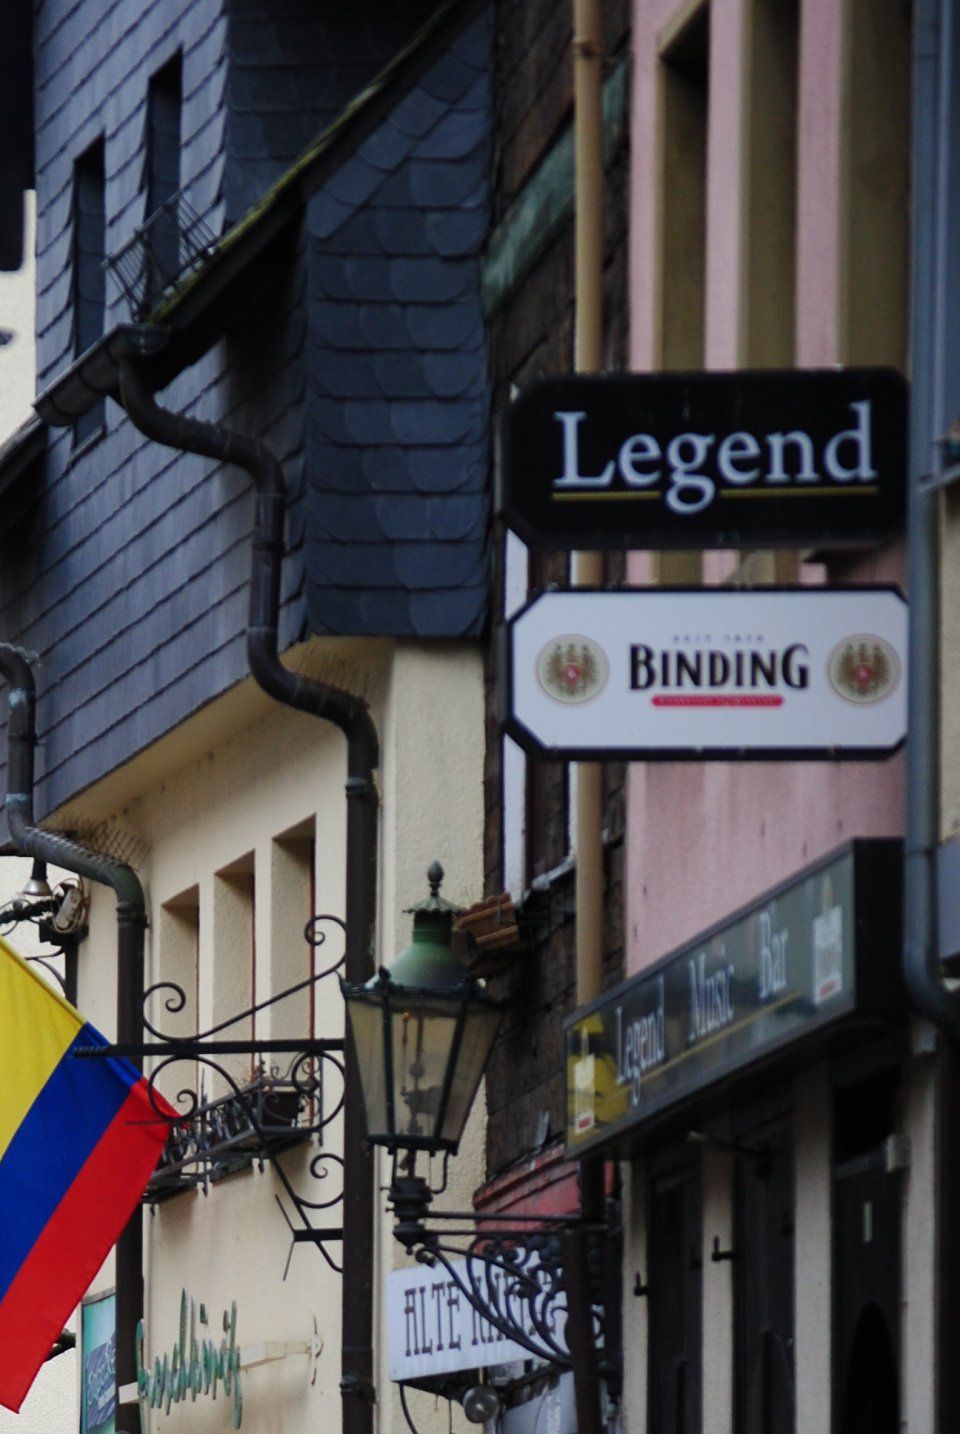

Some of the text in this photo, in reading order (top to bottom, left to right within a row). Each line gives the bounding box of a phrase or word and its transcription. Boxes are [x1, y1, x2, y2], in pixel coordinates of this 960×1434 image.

[553, 399, 878, 514] Legend
[628, 642, 810, 691] BINDING
[615, 975, 665, 1106] Legend
[758, 909, 788, 1000] Bar
[405, 1280, 462, 1357] ALTE
